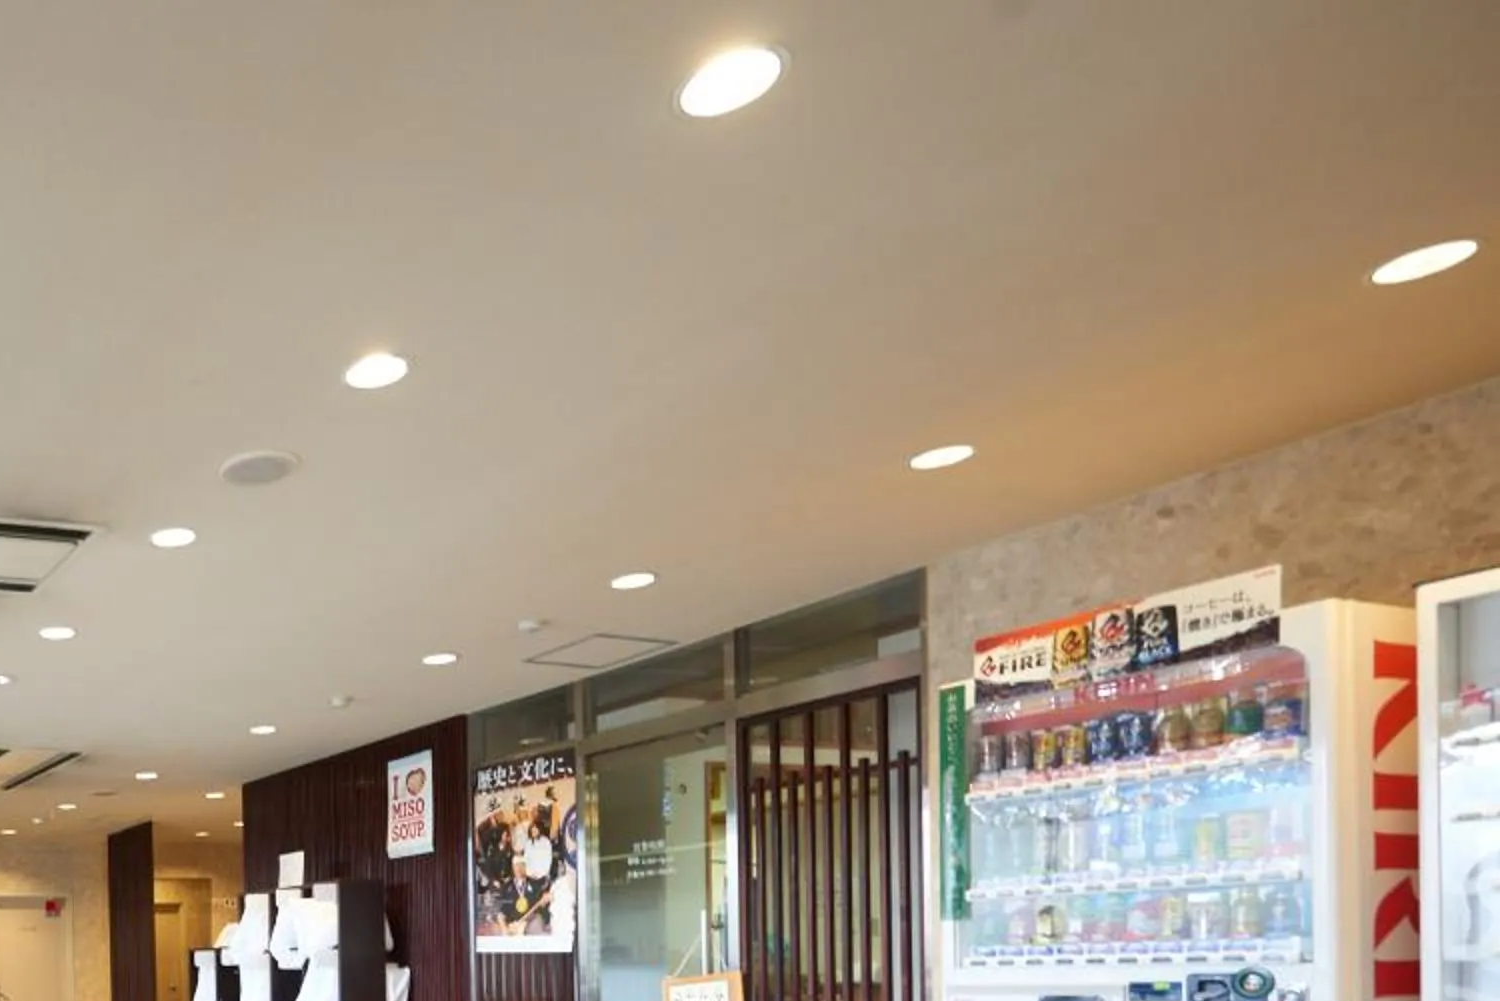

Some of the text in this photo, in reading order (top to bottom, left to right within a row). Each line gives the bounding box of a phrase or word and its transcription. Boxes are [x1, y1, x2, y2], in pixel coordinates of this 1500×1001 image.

[999, 652, 1047, 675] FIRE
[477, 757, 574, 792] 歴史と文化に、
[393, 775, 400, 800] I
[392, 797, 425, 819] MISO
[391, 821, 425, 842] SOUP
